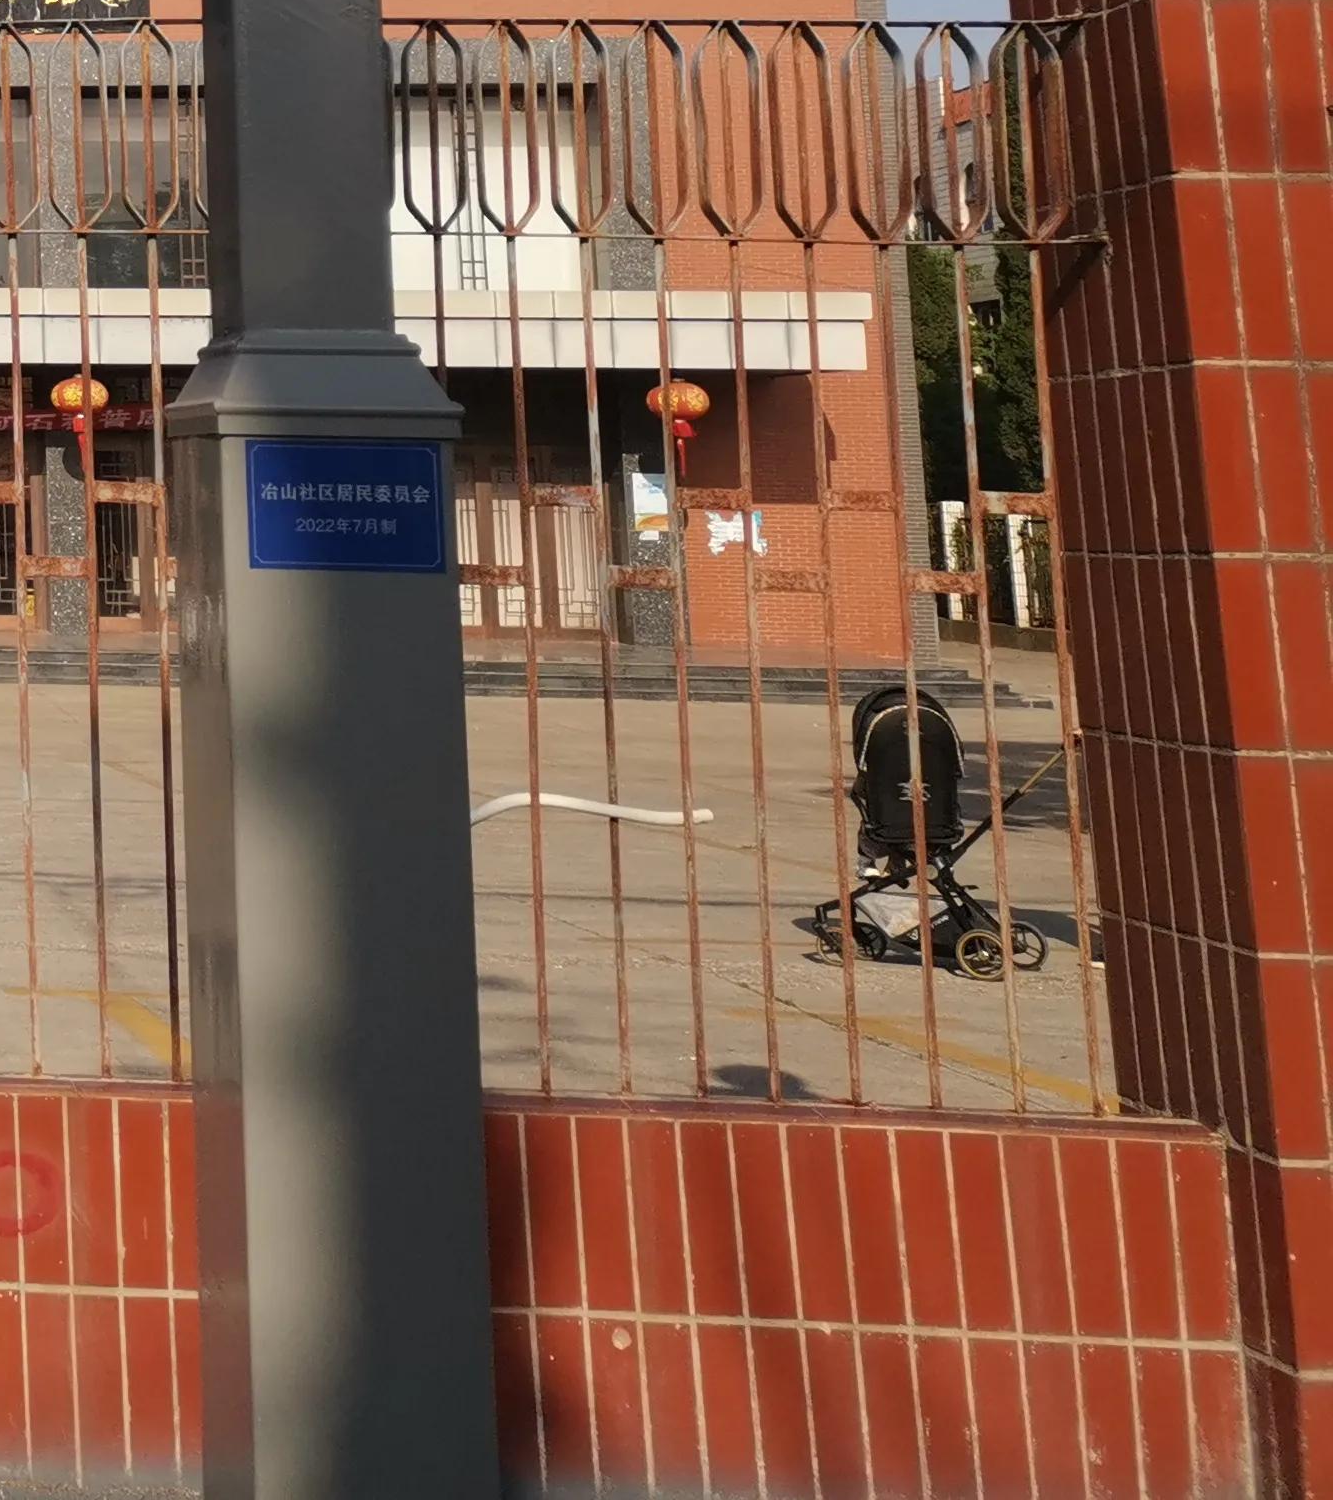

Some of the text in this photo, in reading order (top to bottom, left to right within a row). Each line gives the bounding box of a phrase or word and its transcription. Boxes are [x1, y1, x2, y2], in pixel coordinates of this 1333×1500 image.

[260, 482, 431, 504] 冶山社区居民委员会
[295, 517, 398, 535] 2022年7月制
